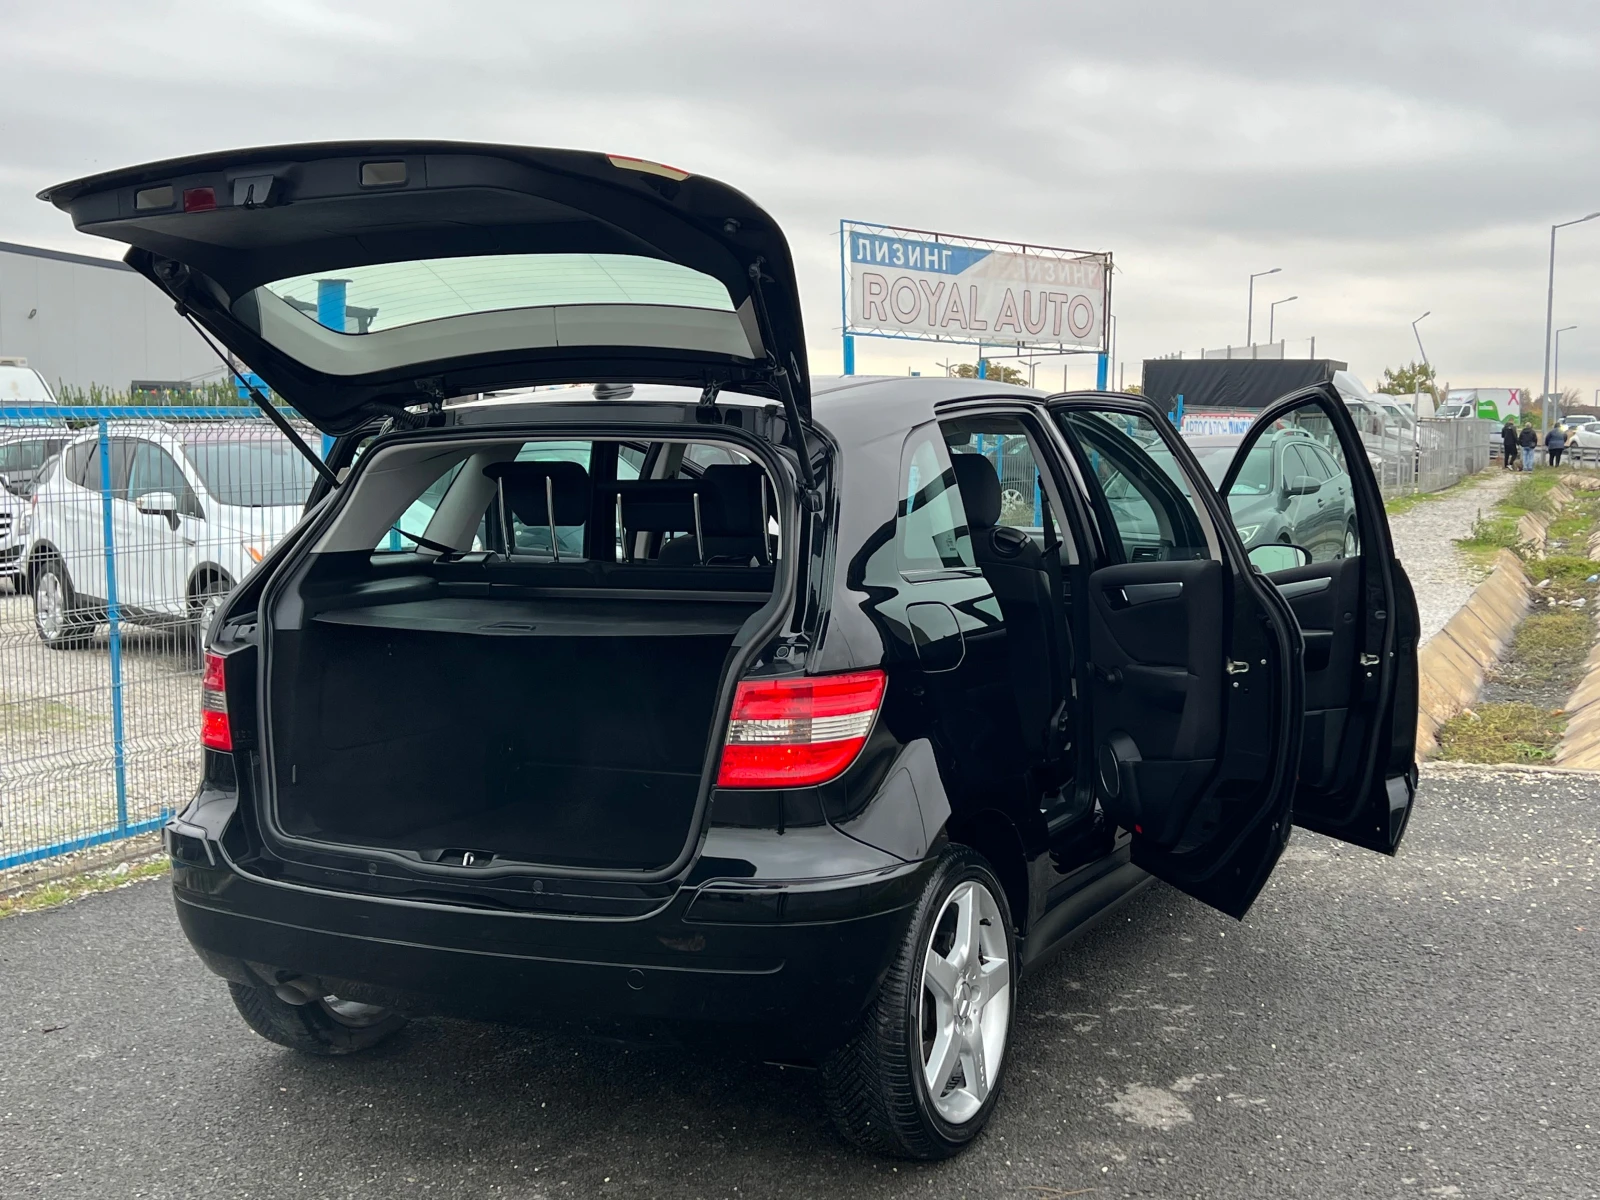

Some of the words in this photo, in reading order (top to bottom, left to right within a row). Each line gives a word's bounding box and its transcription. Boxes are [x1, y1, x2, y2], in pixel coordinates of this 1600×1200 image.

[857, 238, 952, 271] ЛИЗИНГ
[862, 272, 987, 331] ROYAL
[994, 288, 1095, 338] AUTO
